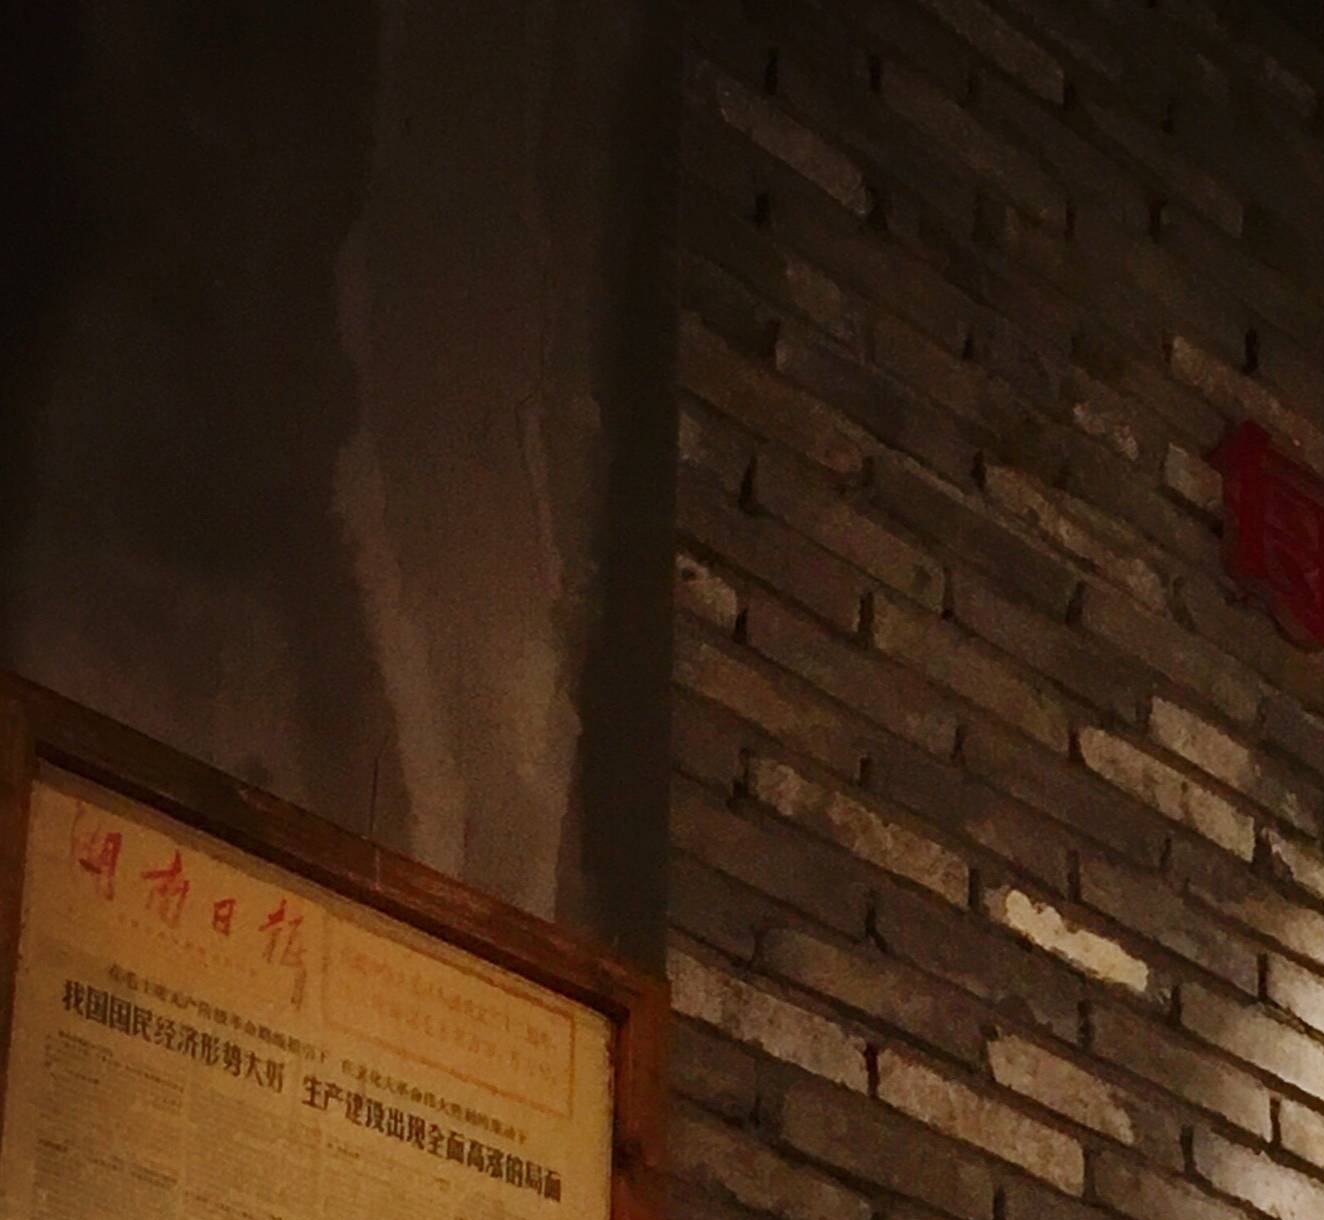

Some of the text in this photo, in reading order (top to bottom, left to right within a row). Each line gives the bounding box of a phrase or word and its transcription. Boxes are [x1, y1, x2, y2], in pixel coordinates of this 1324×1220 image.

[61, 978, 286, 1094] 我国国民经济形势大好
[302, 1074, 562, 1204] 生产建设出现全面高涨的局面
